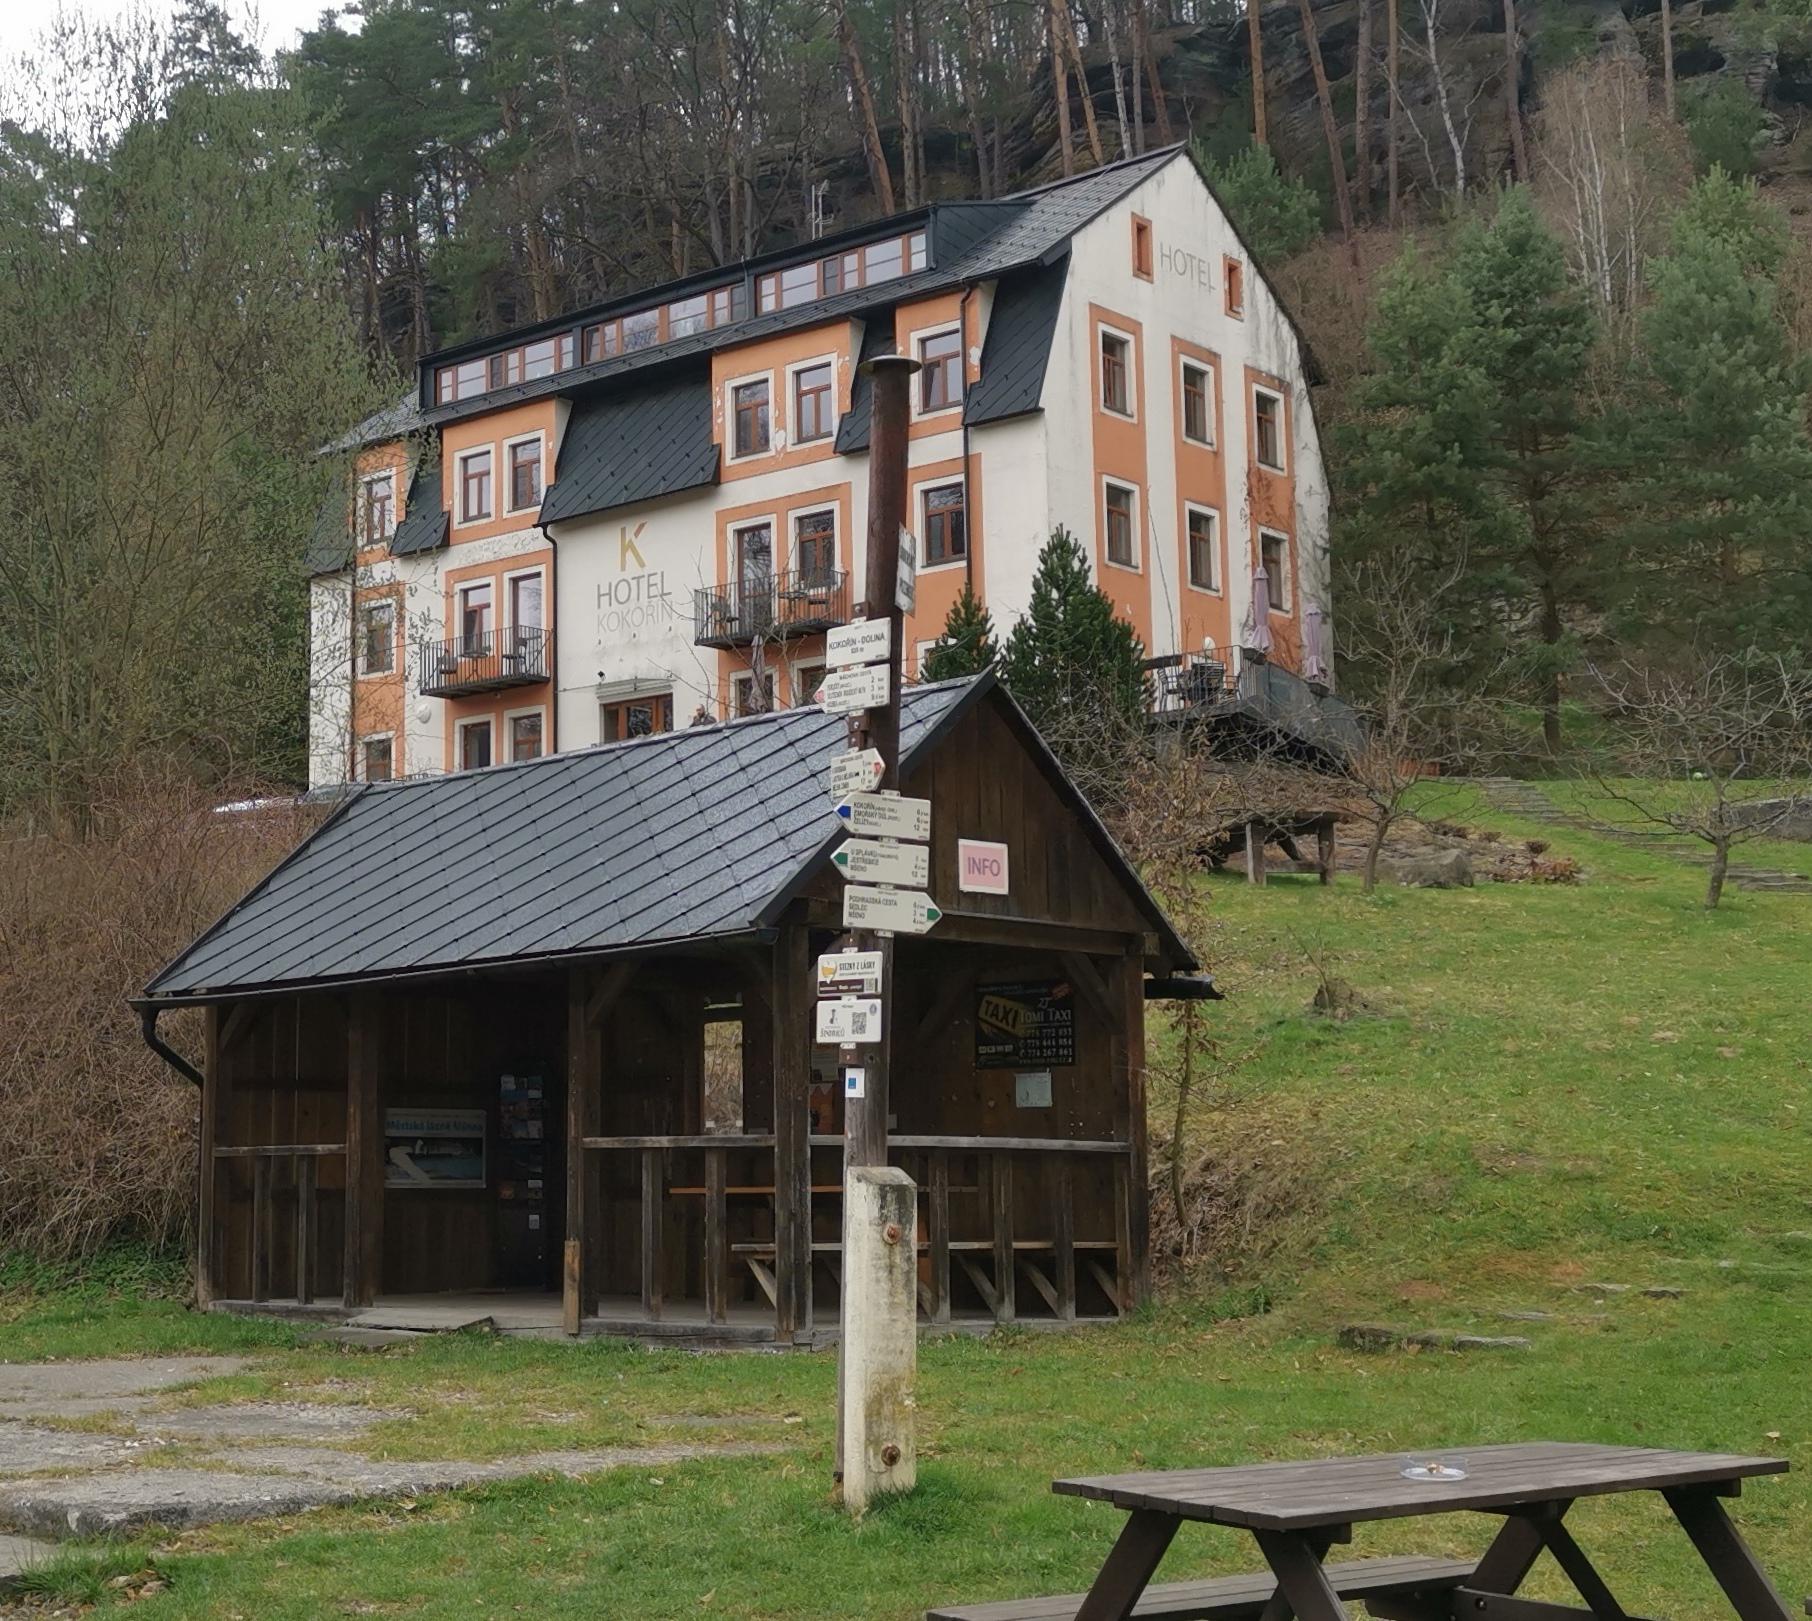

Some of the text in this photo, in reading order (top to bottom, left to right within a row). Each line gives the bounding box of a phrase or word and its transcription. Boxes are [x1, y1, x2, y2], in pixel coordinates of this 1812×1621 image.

[1160, 242, 1216, 292] HOTEL
[620, 521, 647, 572] K
[597, 571, 672, 610] HOTEL
[597, 600, 673, 633] KOKOŘÍN
[829, 636, 857, 650] KOKOŘÍN
[861, 632, 886, 644] DOLINA
[968, 857, 1001, 877] INFO
[860, 960, 876, 970] LÁSKY
[984, 1001, 1018, 1030] TAXI
[1047, 1008, 1072, 1021] TAXI
